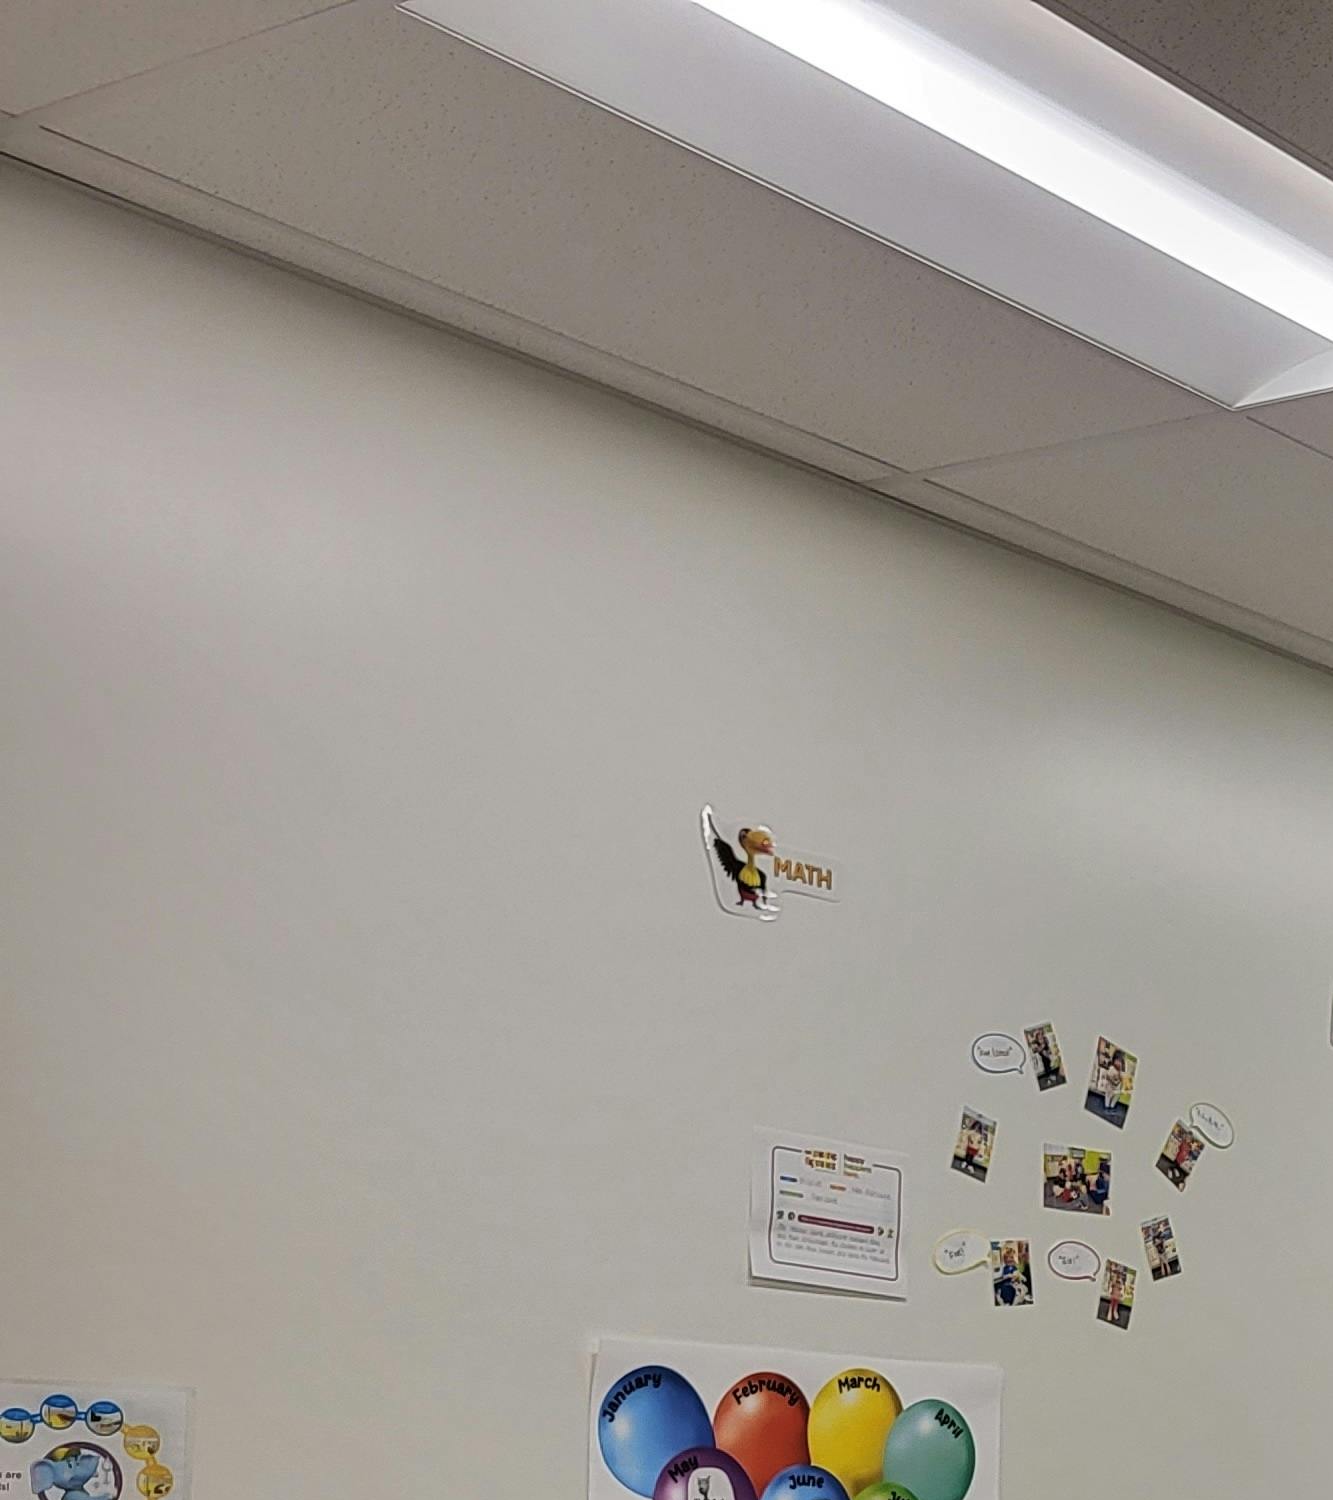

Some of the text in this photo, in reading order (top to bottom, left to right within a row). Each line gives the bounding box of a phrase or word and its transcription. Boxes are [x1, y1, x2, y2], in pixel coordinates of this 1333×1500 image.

[774, 856, 832, 890] MATH
[602, 1373, 662, 1423] January
[732, 1379, 800, 1407] February
[838, 1376, 881, 1394] March
[934, 1408, 964, 1439] April
[667, 1456, 699, 1483] May
[788, 1474, 824, 1490] June
